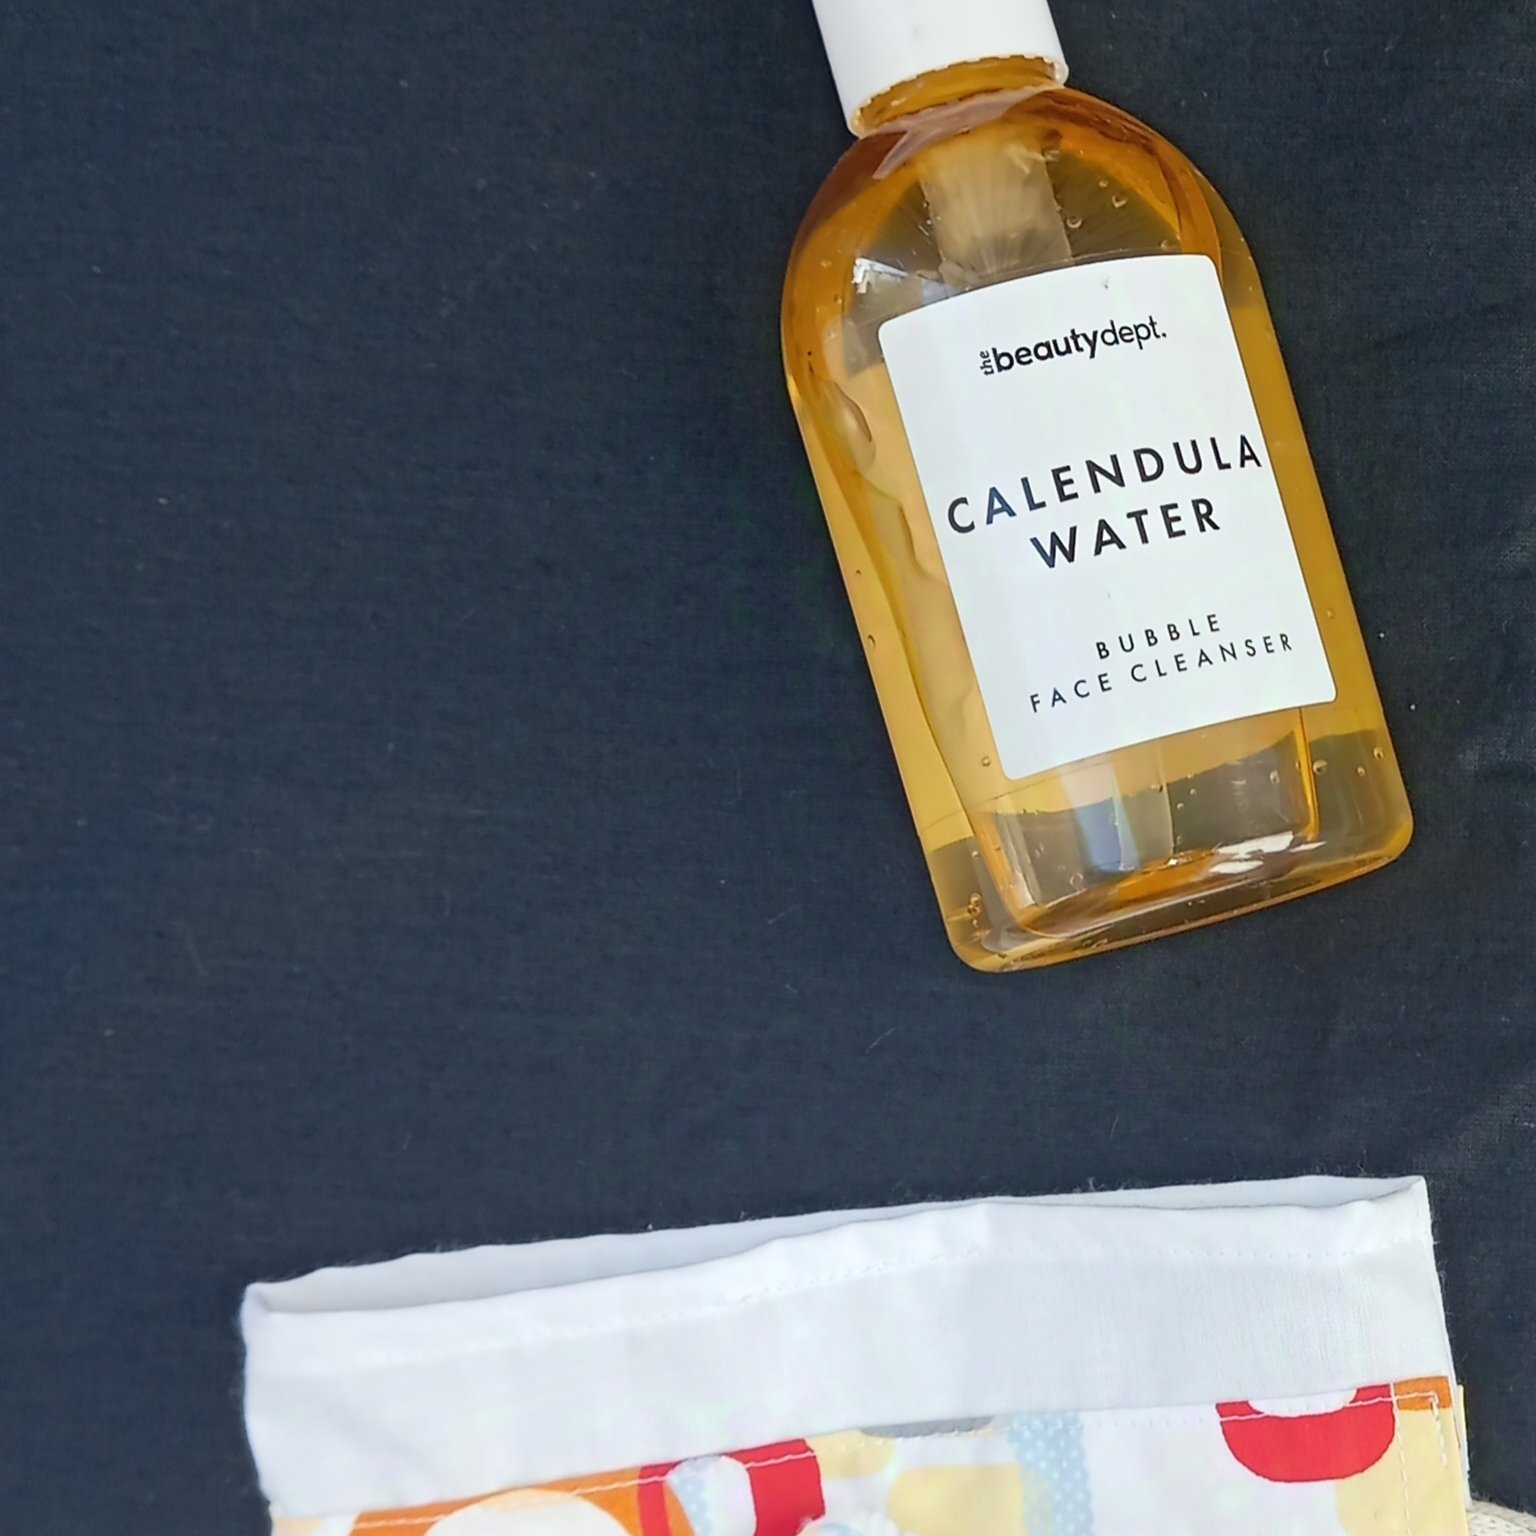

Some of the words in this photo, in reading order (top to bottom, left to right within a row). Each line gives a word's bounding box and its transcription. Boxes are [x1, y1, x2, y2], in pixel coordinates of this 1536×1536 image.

[979, 350, 995, 376] the
[947, 434, 1263, 534] CALENDULA
[1029, 498, 1221, 569] WATER
[1030, 672, 1113, 713] FACE
[1130, 632, 1293, 683] CLEANSER
[1095, 614, 1221, 661] BUBBLE
